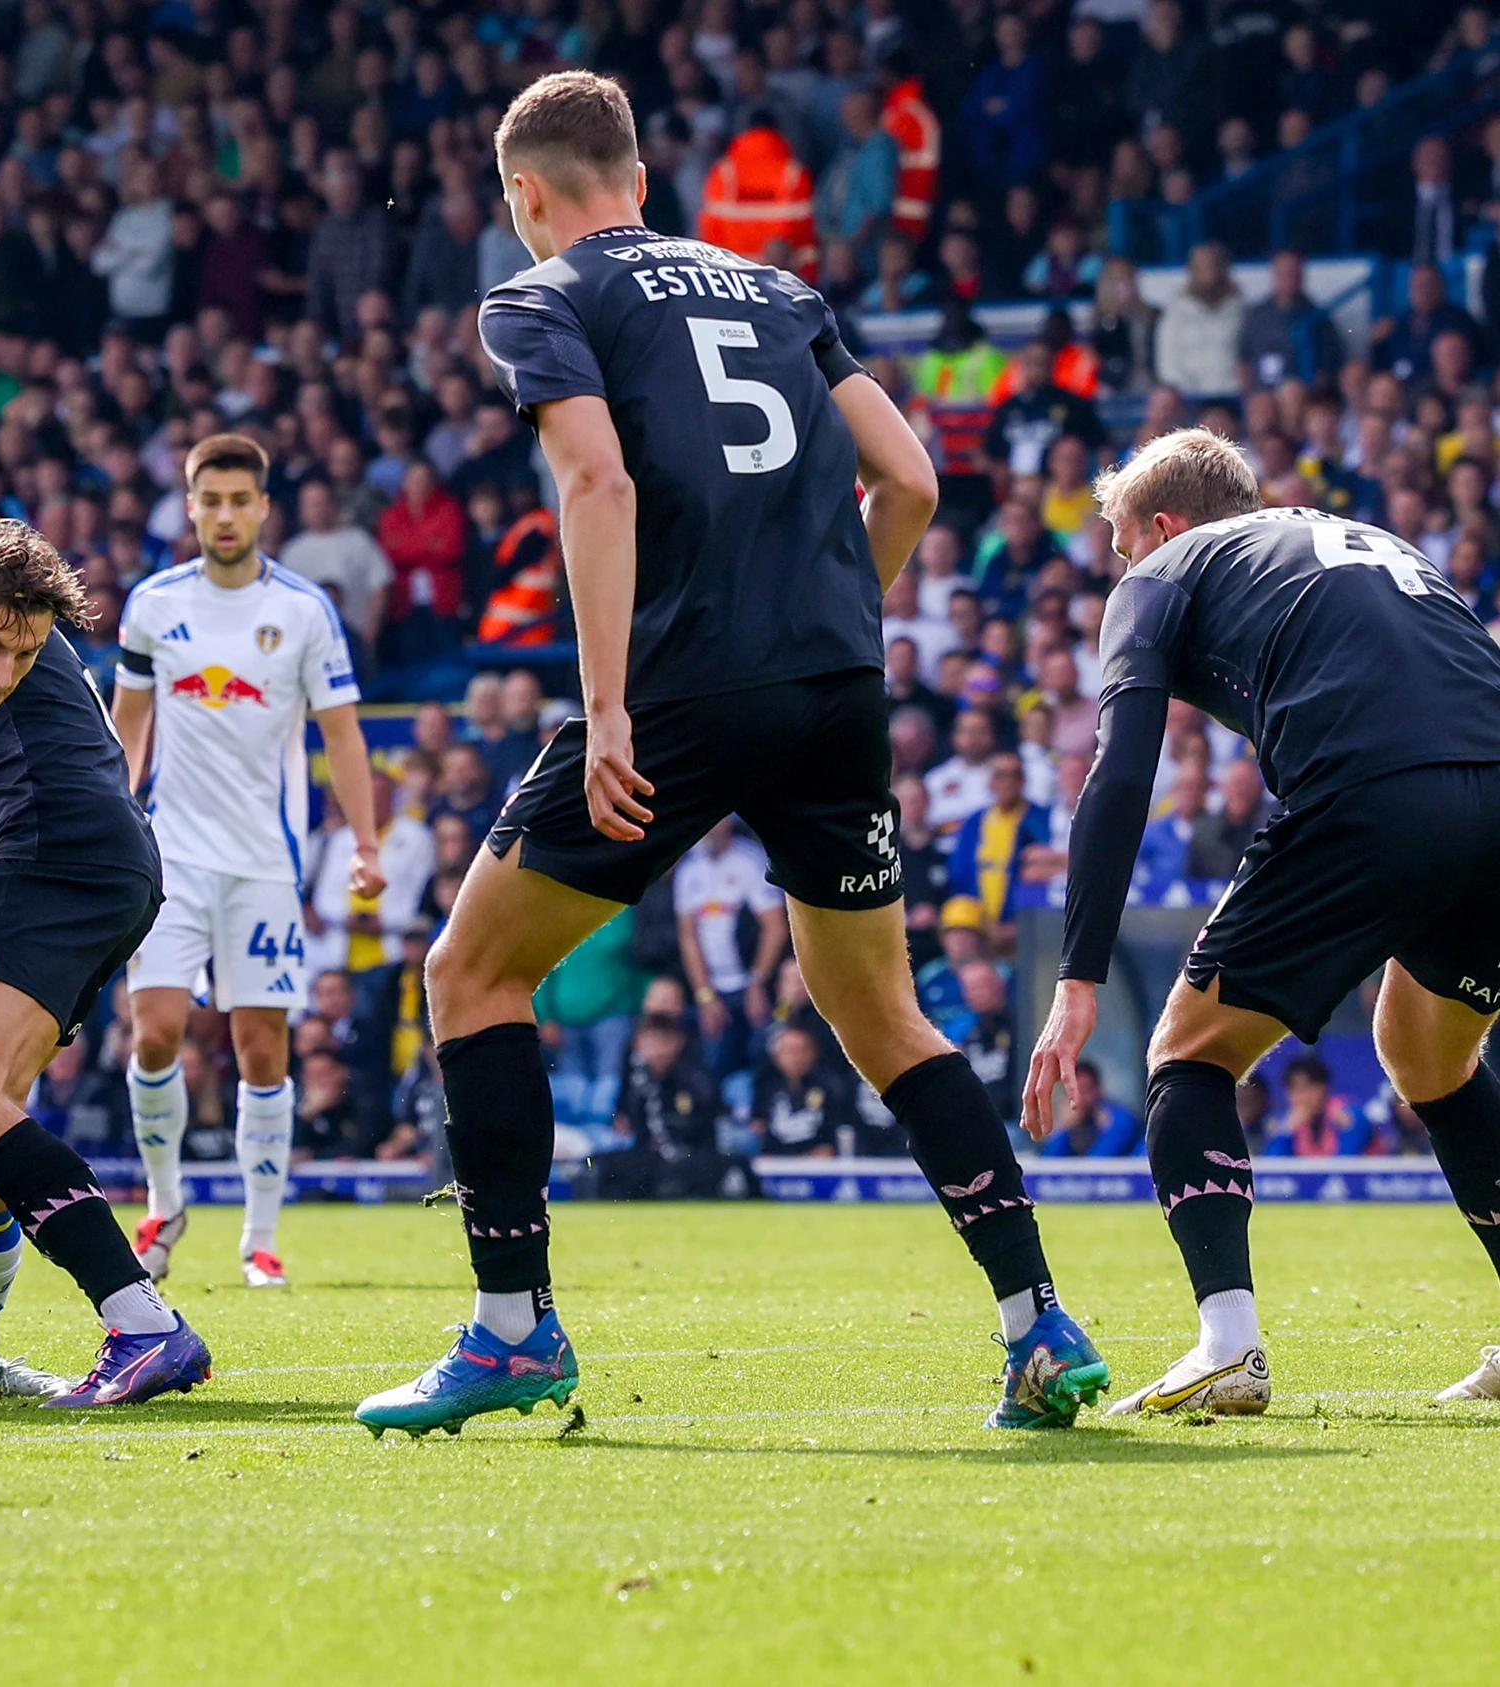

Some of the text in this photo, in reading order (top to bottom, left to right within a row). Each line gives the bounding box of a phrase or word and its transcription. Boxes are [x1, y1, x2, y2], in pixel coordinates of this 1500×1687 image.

[686, 317, 797, 474] 5
[1310, 522, 1434, 596] 4
[840, 853, 901, 892] RAPID
[247, 922, 304, 967] 44
